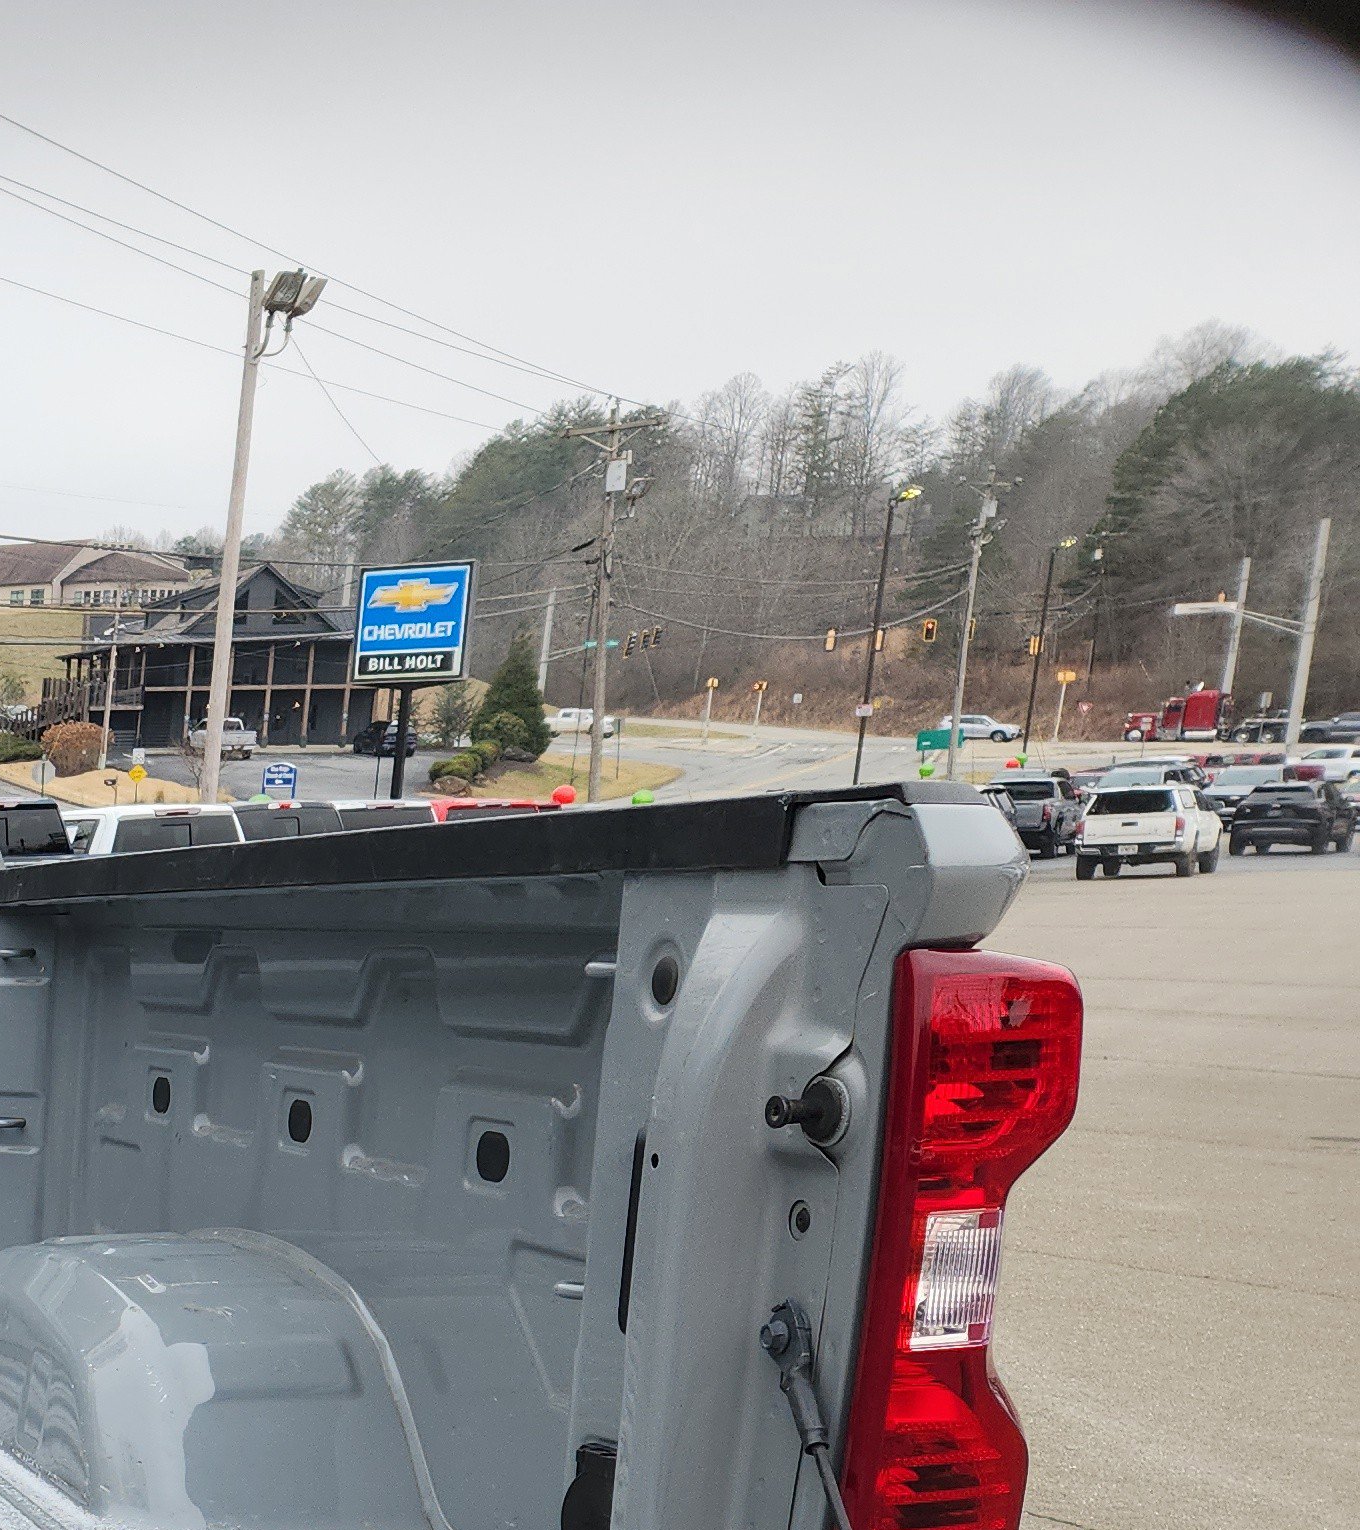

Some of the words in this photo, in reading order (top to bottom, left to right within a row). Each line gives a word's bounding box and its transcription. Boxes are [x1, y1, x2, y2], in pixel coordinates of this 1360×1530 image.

[364, 621, 456, 641] CHEVROLET
[368, 657, 402, 672] BILL
[404, 654, 444, 669] HOLT
